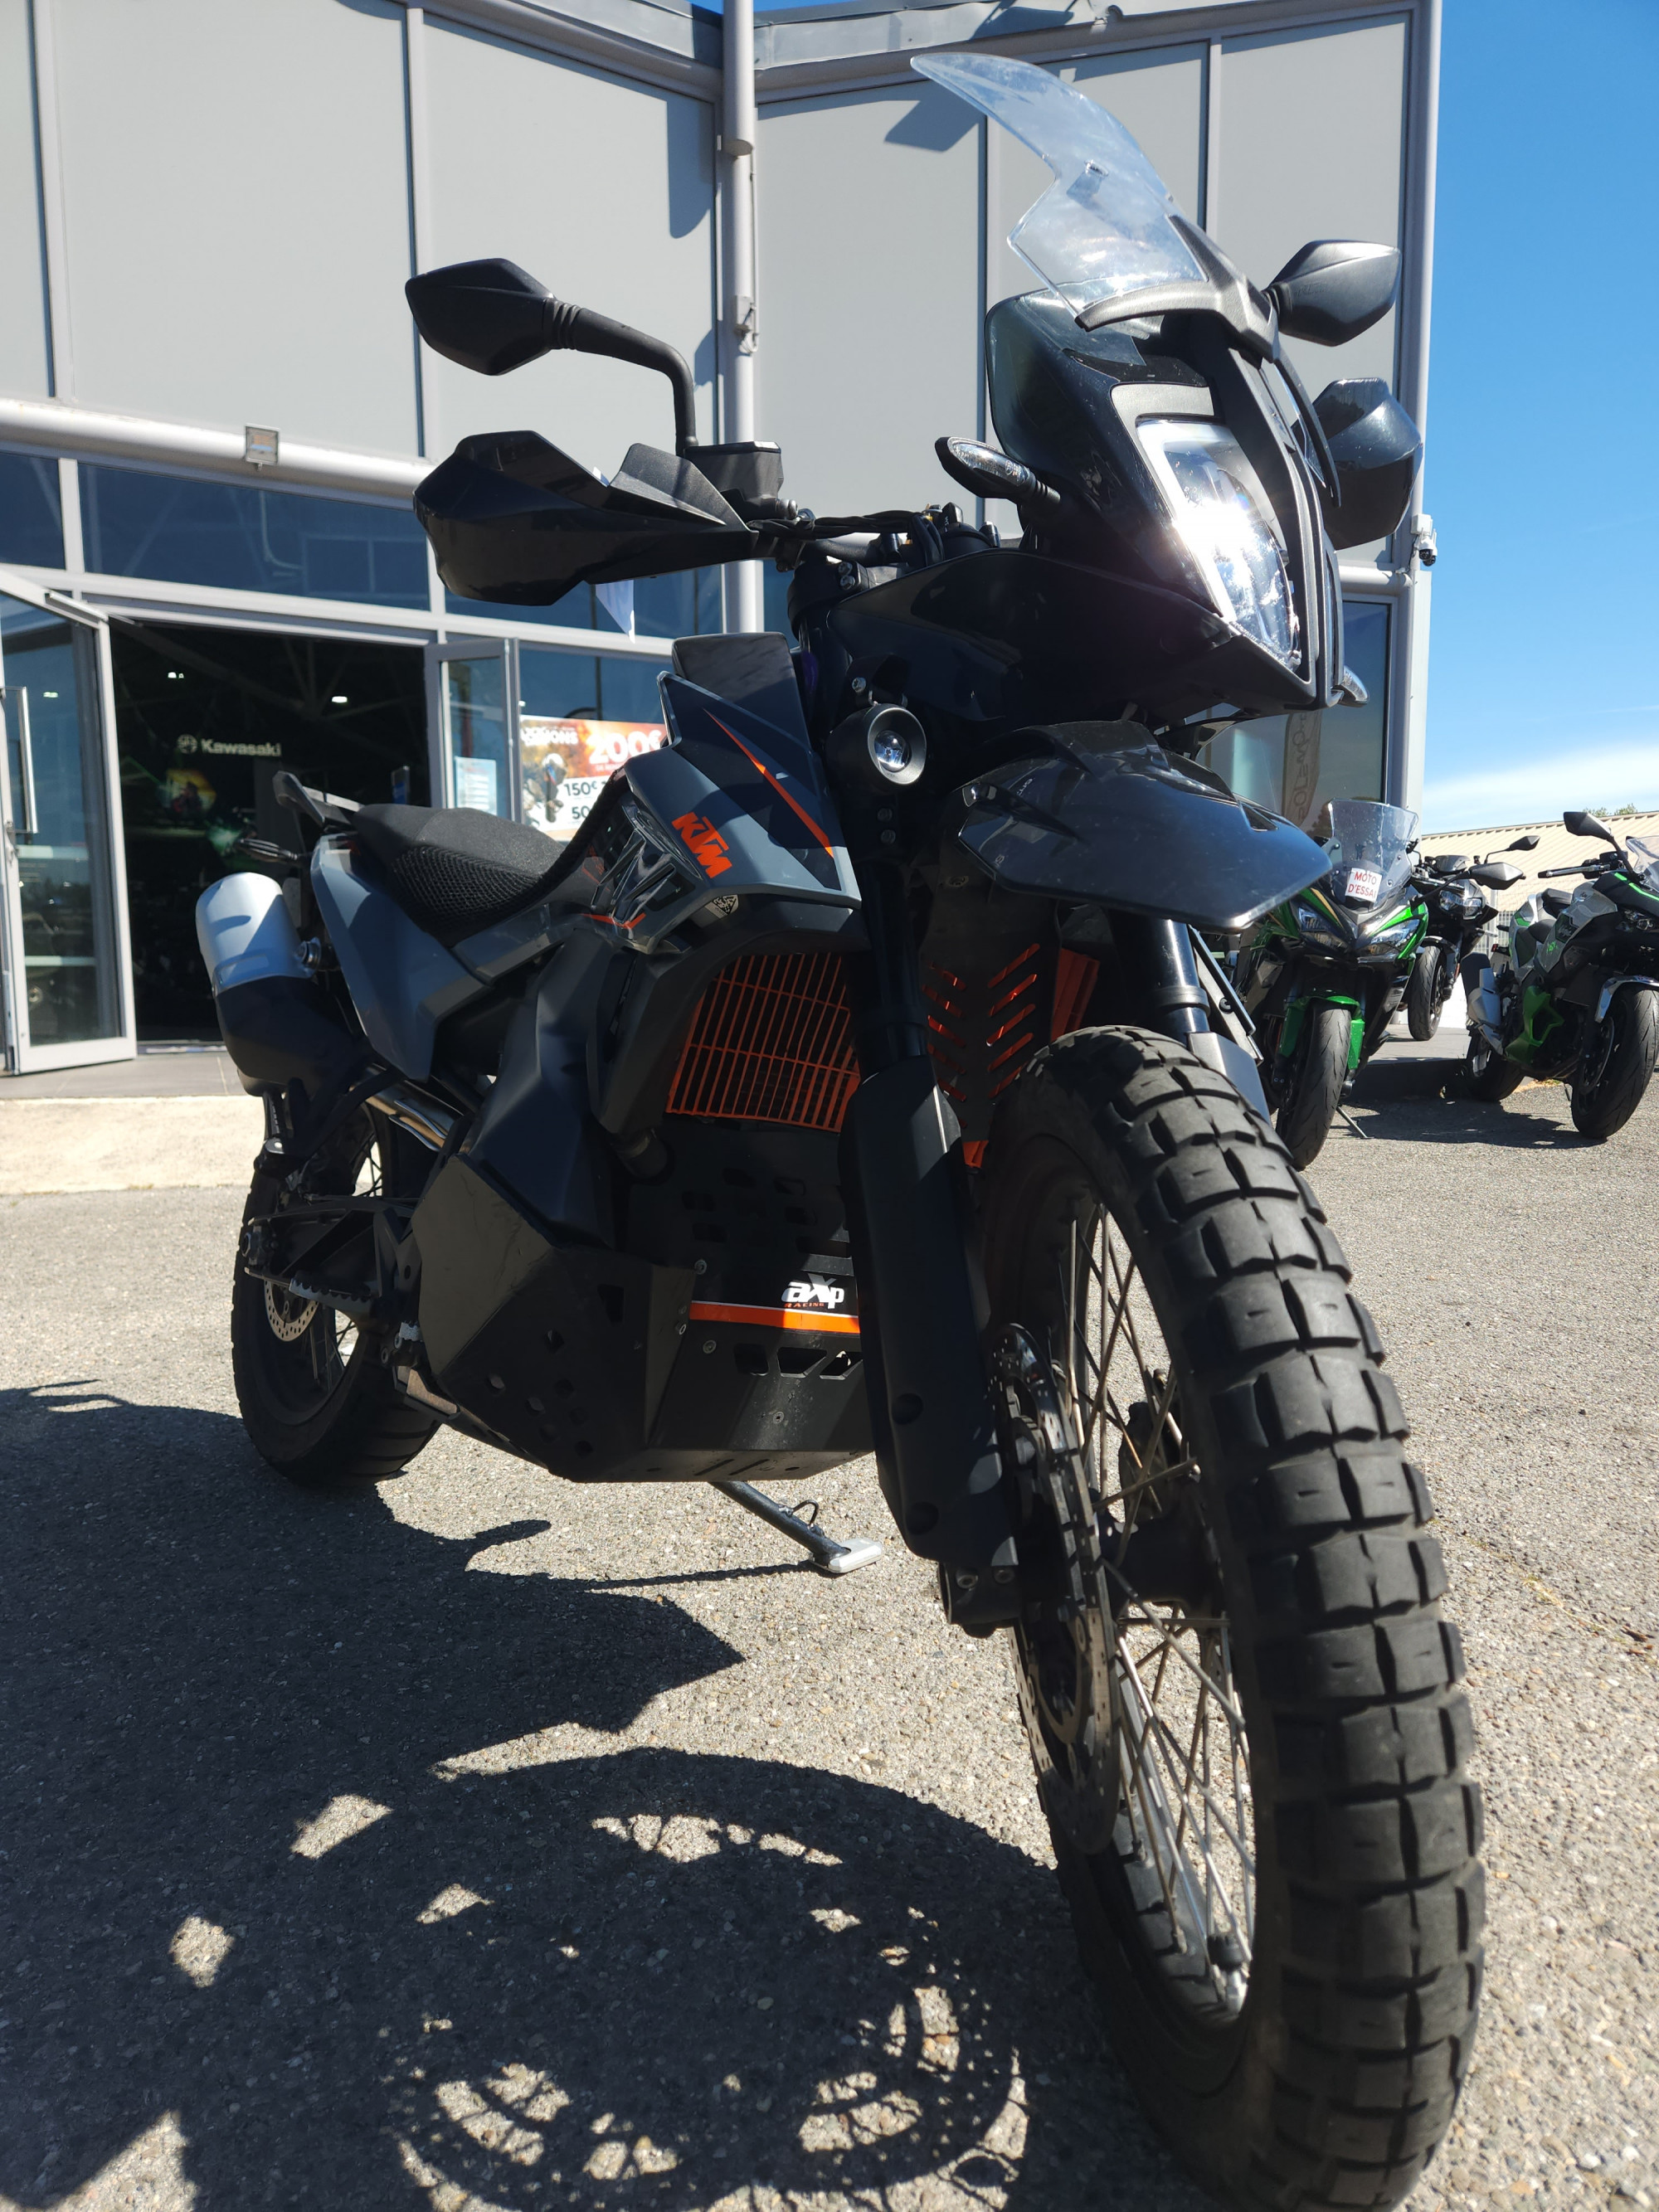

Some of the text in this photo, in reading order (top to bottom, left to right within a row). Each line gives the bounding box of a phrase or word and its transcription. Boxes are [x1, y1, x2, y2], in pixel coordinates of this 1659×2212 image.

[201, 738, 281, 756] Kawasaki
[586, 730, 661, 765] 200€
[564, 780, 597, 796] 150€
[671, 811, 732, 879] KTM
[1354, 871, 1377, 885] MOTO
[1348, 883, 1377, 898] D'ESSAI
